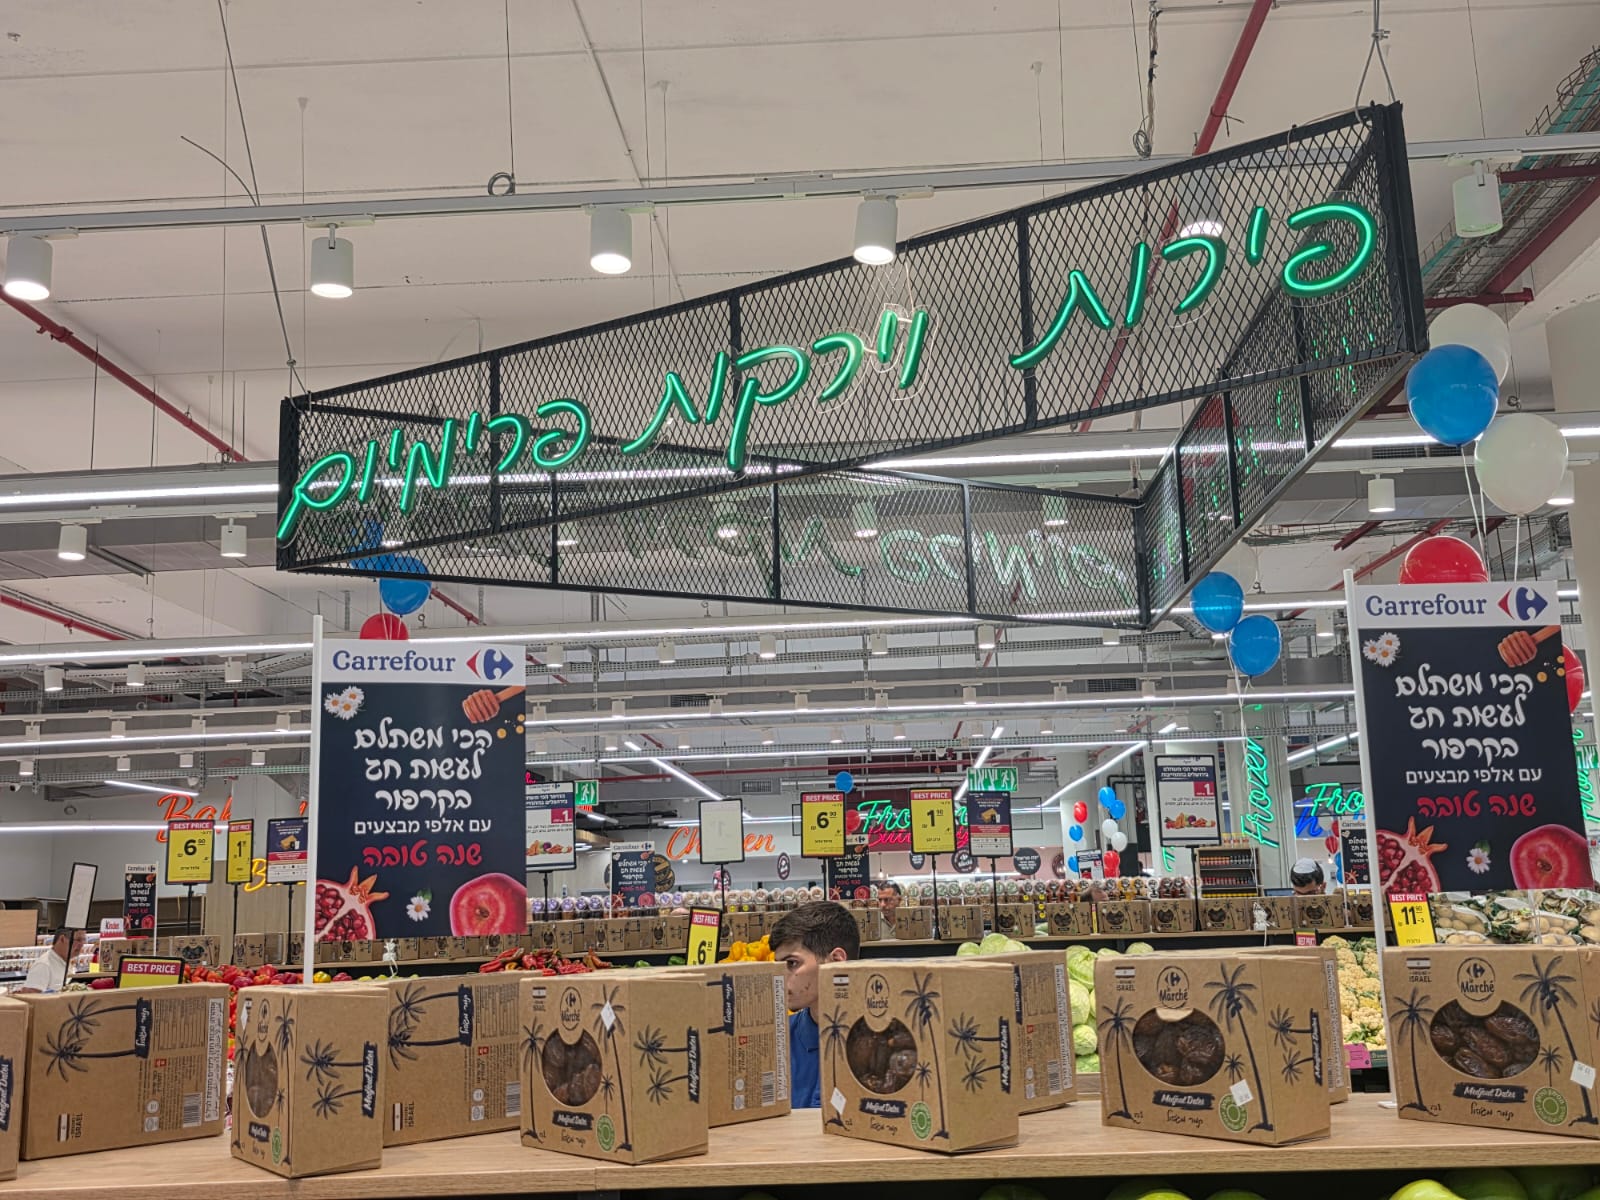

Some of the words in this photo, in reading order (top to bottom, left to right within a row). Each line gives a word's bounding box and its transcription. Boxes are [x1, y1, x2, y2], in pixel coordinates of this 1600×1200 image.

[1010, 199, 1379, 370] פירות
[622, 309, 930, 473] וירקות
[275, 398, 591, 540] פרימיום
[1365, 593, 1487, 616] Carrefour
[332, 650, 457, 672] Carrefour
[1395, 663, 1483, 697] משתלם
[1491, 673, 1533, 695] הכי
[1408, 705, 1445, 730] חג
[1452, 693, 1527, 728] לעשות
[353, 717, 444, 750] משתלם
[452, 729, 493, 749] הכי
[1421, 737, 1519, 766] בקרפור
[365, 757, 402, 781] חג
[409, 748, 485, 780] לעשות
[1473, 767, 1515, 783] אלפי
[1519, 768, 1542, 782] עם
[1405, 770, 1470, 784] מבצעים
[375, 788, 473, 818] בקרפור
[1304, 782, 1367, 817] Fro
[1416, 790, 1481, 817] טובה
[1488, 793, 1537, 817] שנה
[354, 820, 420, 834] מבצעים
[425, 818, 464, 833] אלפי
[469, 820, 492, 832] עם
[817, 811, 830, 829] 6
[927, 809, 935, 827] 1
[184, 838, 198, 856] 6
[362, 840, 429, 867] טובה
[666, 825, 776, 861] Chen
[436, 843, 483, 866] שנה
[1391, 894, 1405, 902] BEST
[693, 913, 706, 924] BEST
[706, 914, 719, 925] PRICE
[1401, 906, 1417, 925] 11
[697, 939, 707, 965] 6
[127, 963, 149, 973] BEST
[150, 963, 176, 973] PRICE
[1408, 975, 1432, 983] ISRAEL
[1159, 989, 1189, 1002] Marché
[1460, 980, 1495, 994] Marché
[1494, 1088, 1517, 1099] Dates
